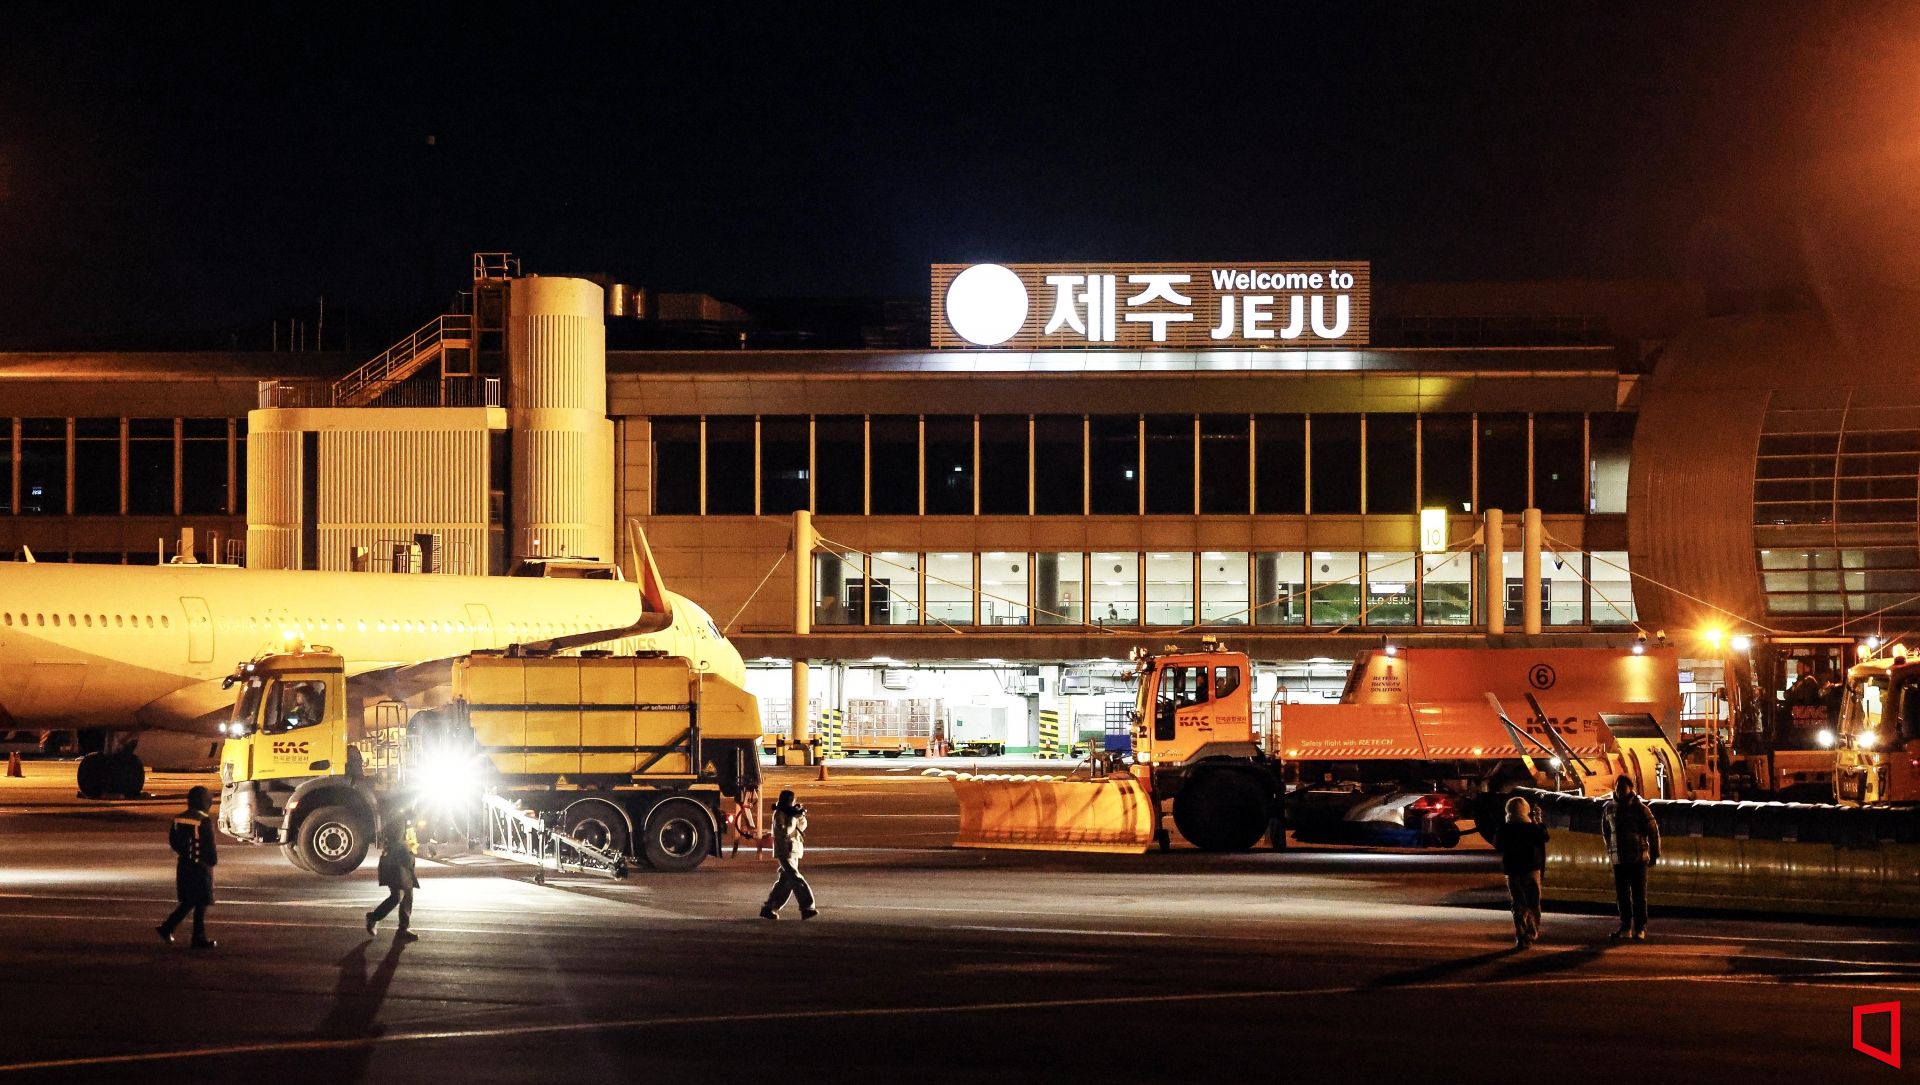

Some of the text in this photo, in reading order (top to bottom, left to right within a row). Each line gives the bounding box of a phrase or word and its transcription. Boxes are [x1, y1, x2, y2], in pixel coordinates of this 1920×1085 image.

[1211, 269, 1354, 290] Welcome to
[1044, 274, 1194, 342] 제주
[1211, 294, 1350, 340] JEJU
[1427, 529, 1441, 546] 10
[1353, 596, 1410, 605] HLLO JEJU
[1179, 716, 1209, 726] KAC
[273, 741, 309, 754] KAC
